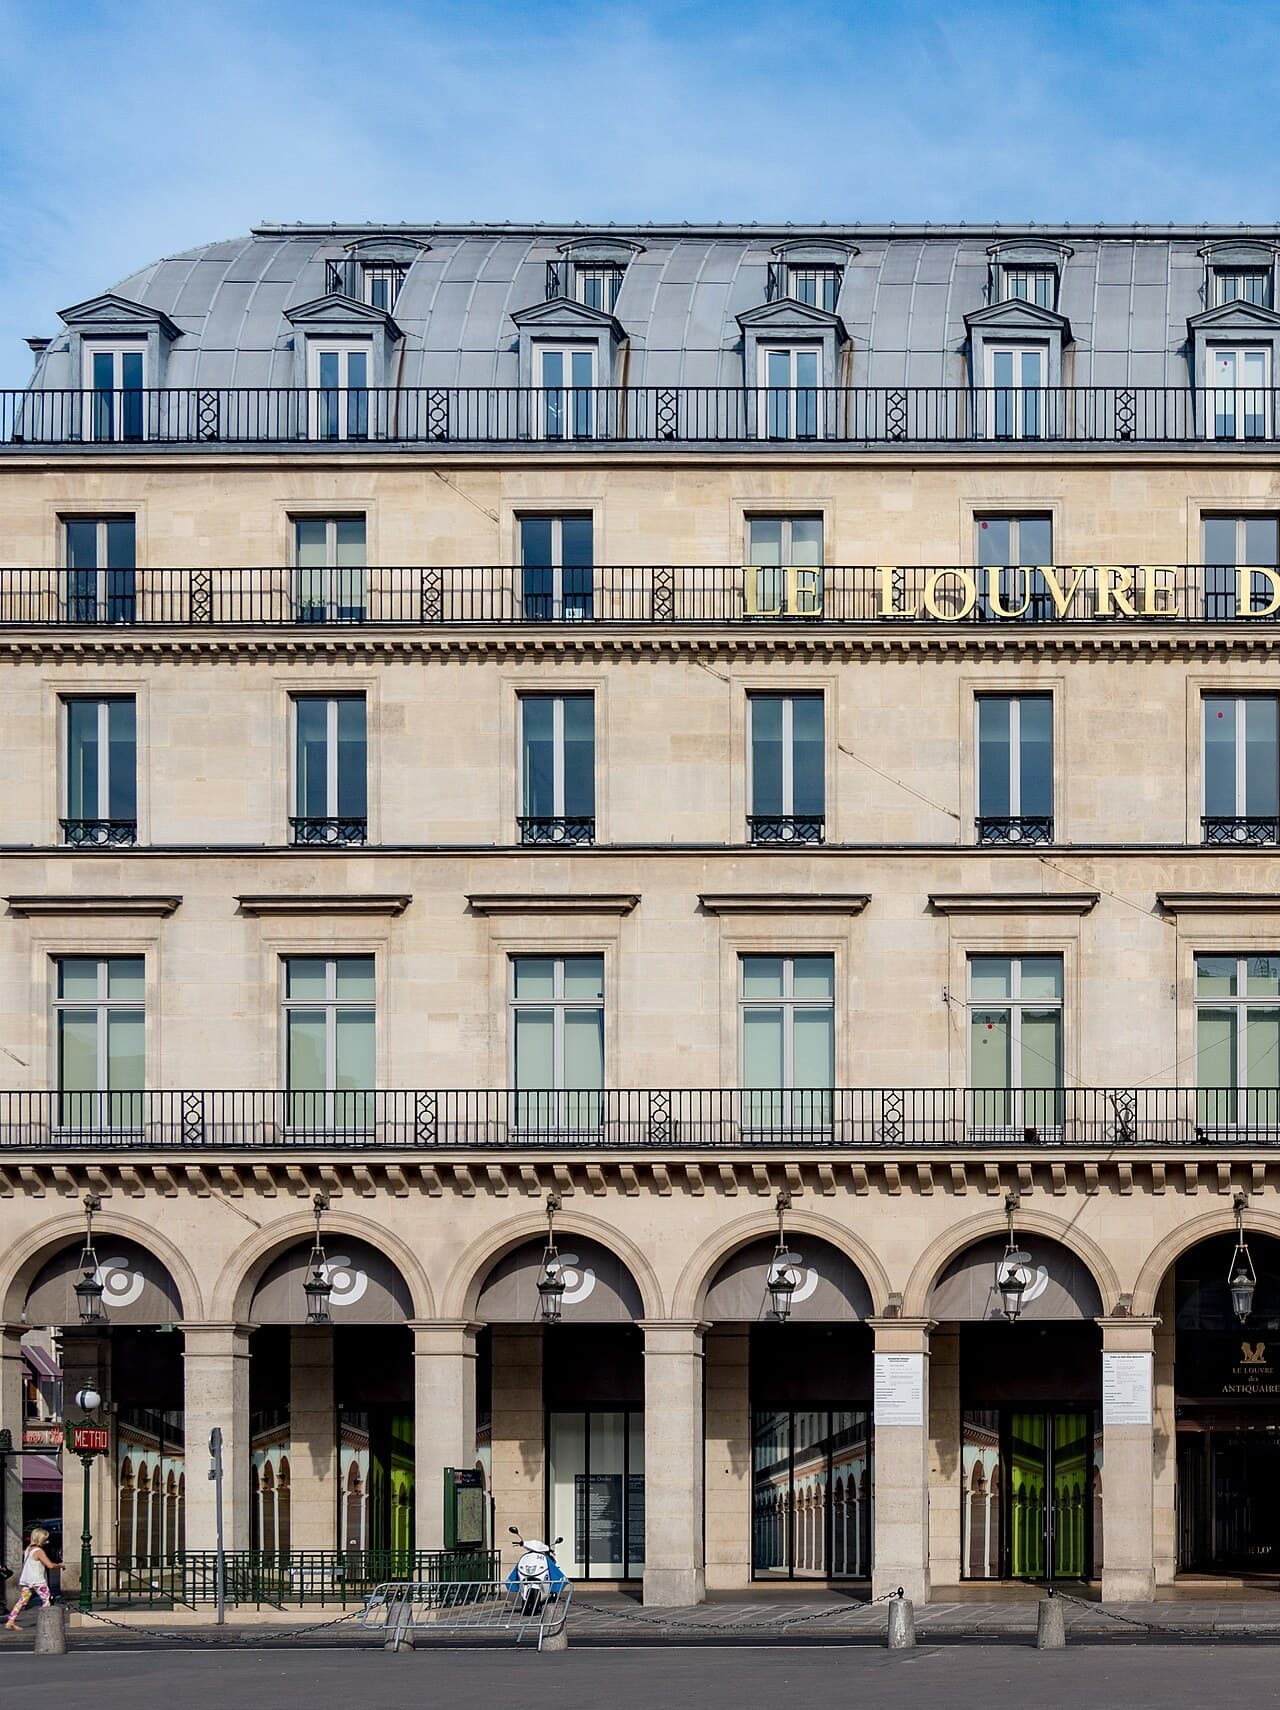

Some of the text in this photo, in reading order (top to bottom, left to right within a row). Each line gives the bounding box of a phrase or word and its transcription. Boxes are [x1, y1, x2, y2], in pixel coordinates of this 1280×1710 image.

[741, 566, 823, 617] LE
[876, 565, 1180, 621] LOUVRE
[1058, 864, 1208, 891] GRAND
